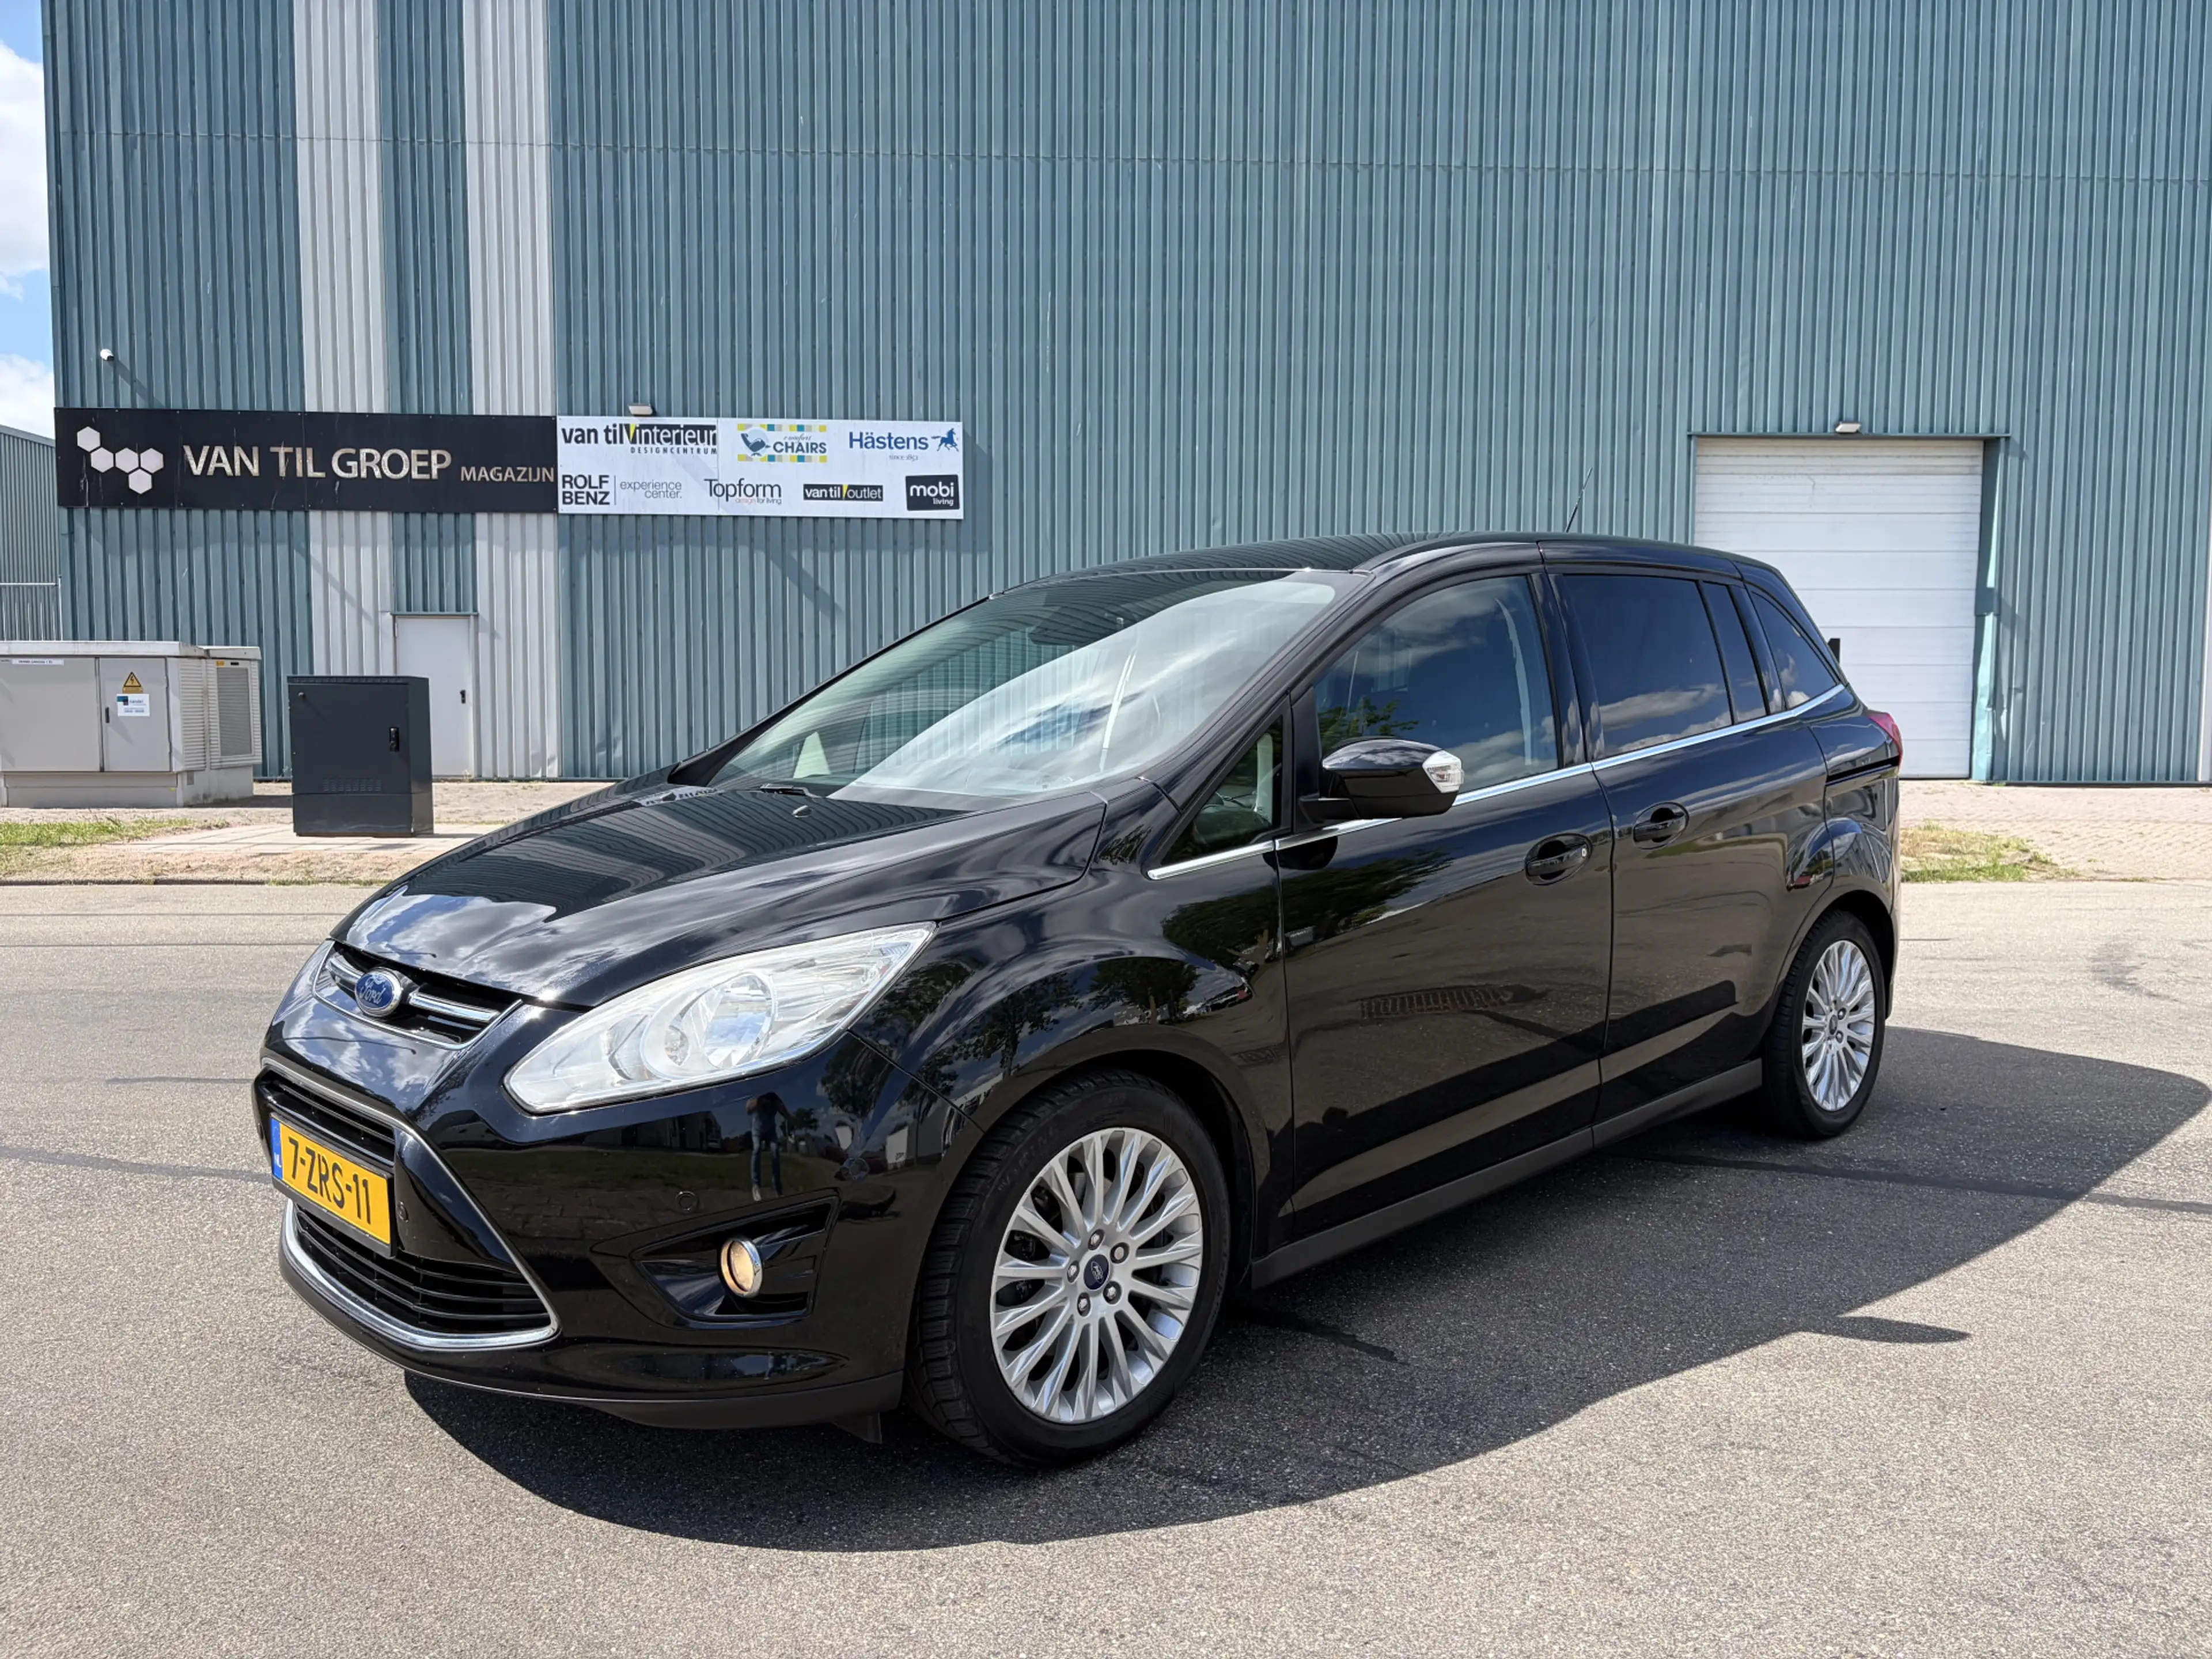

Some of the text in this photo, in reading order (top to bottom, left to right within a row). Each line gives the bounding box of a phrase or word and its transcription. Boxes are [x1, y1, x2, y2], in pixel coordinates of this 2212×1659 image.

[561, 427, 599, 444] van
[603, 423, 624, 444] til
[849, 431, 929, 450] Hästens
[630, 446, 718, 454] DESIGNCENTRUM
[772, 441, 827, 454] CHAIRS
[183, 445, 554, 483] VAN TIL GROEP MAGAZIJN
[562, 474, 682, 493] ROLF experience
[704, 478, 782, 502] Topform
[847, 487, 882, 499] outlet
[910, 481, 955, 497] mobi
[562, 491, 611, 505] BENZ
[933, 498, 955, 507] living
[358, 977, 387, 1005] Ford
[288, 1136, 371, 1225] 7-ZRS-11
